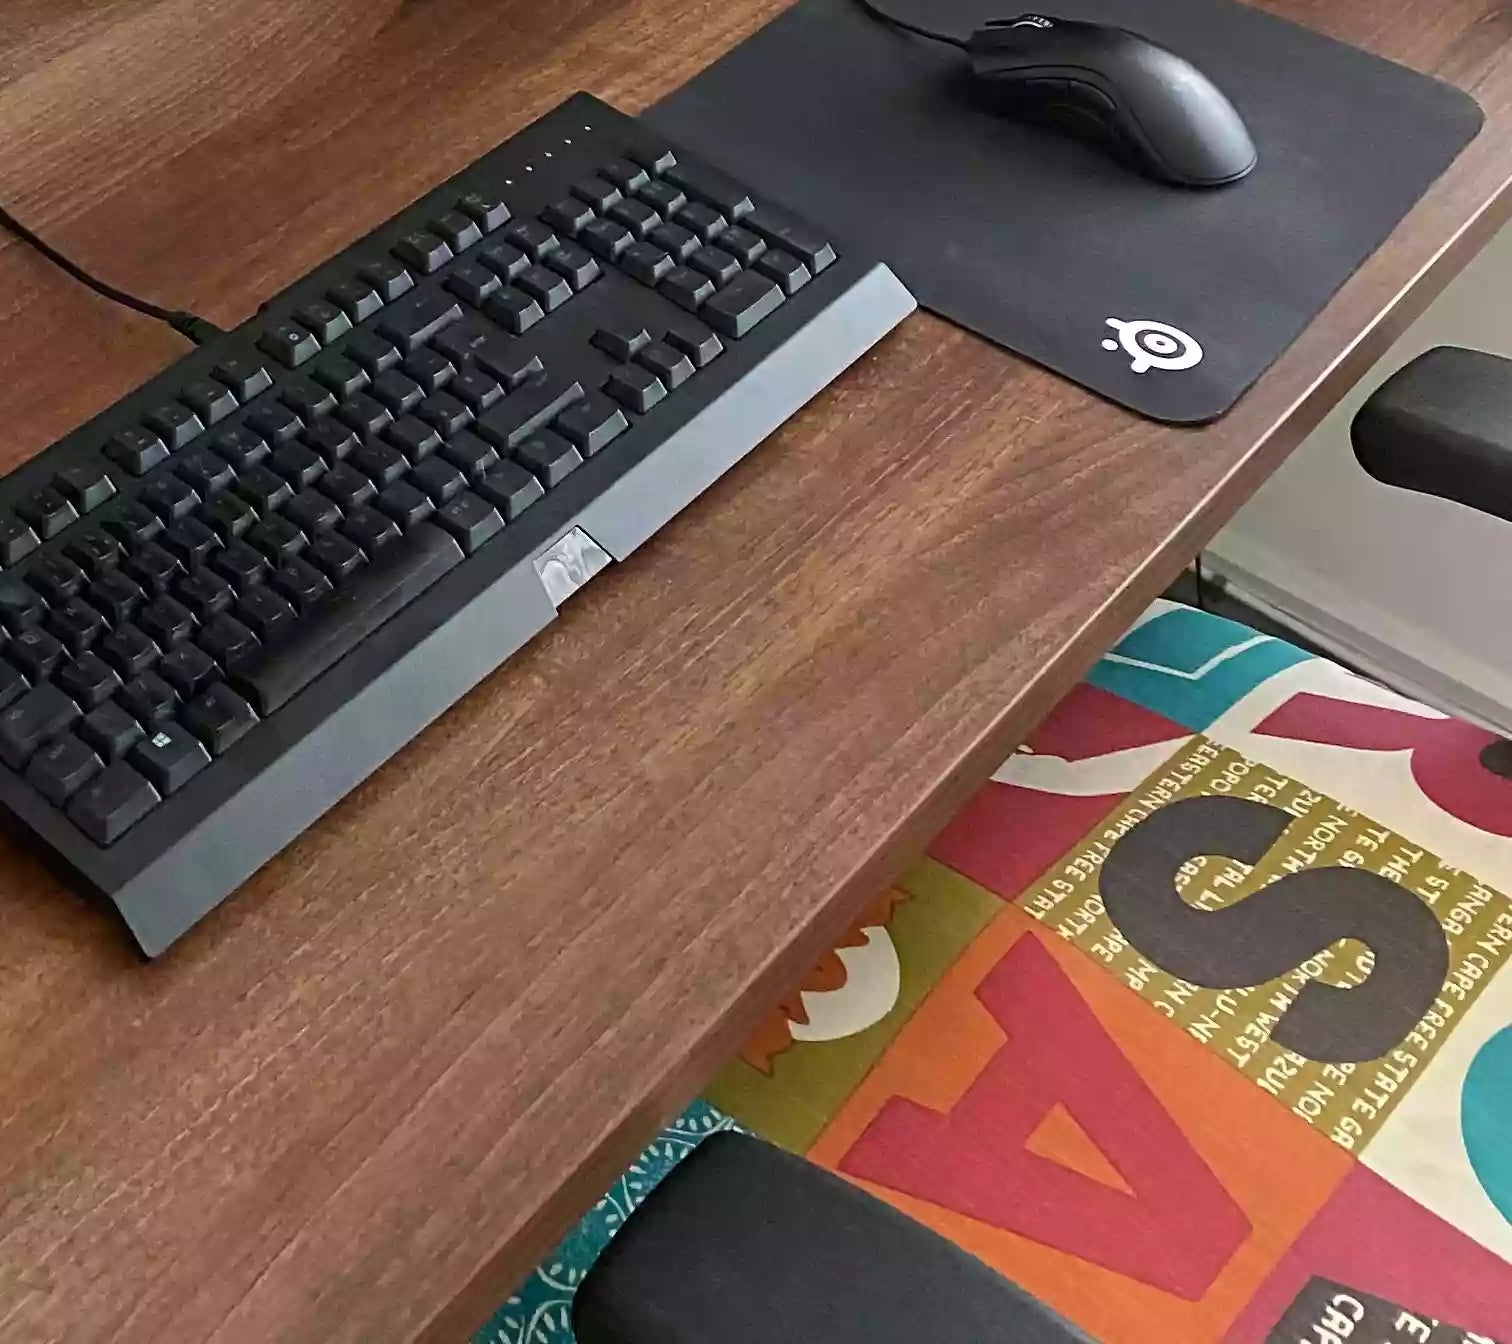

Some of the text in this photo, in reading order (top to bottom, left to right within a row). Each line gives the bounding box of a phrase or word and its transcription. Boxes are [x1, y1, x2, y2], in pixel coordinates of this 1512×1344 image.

[1063, 840, 1111, 882] FREE
[1280, 813, 1349, 874] NORTH
[1440, 951, 1490, 1001] CAPE
[1403, 996, 1455, 1052] FREE
[1350, 1048, 1419, 1120] STATE
